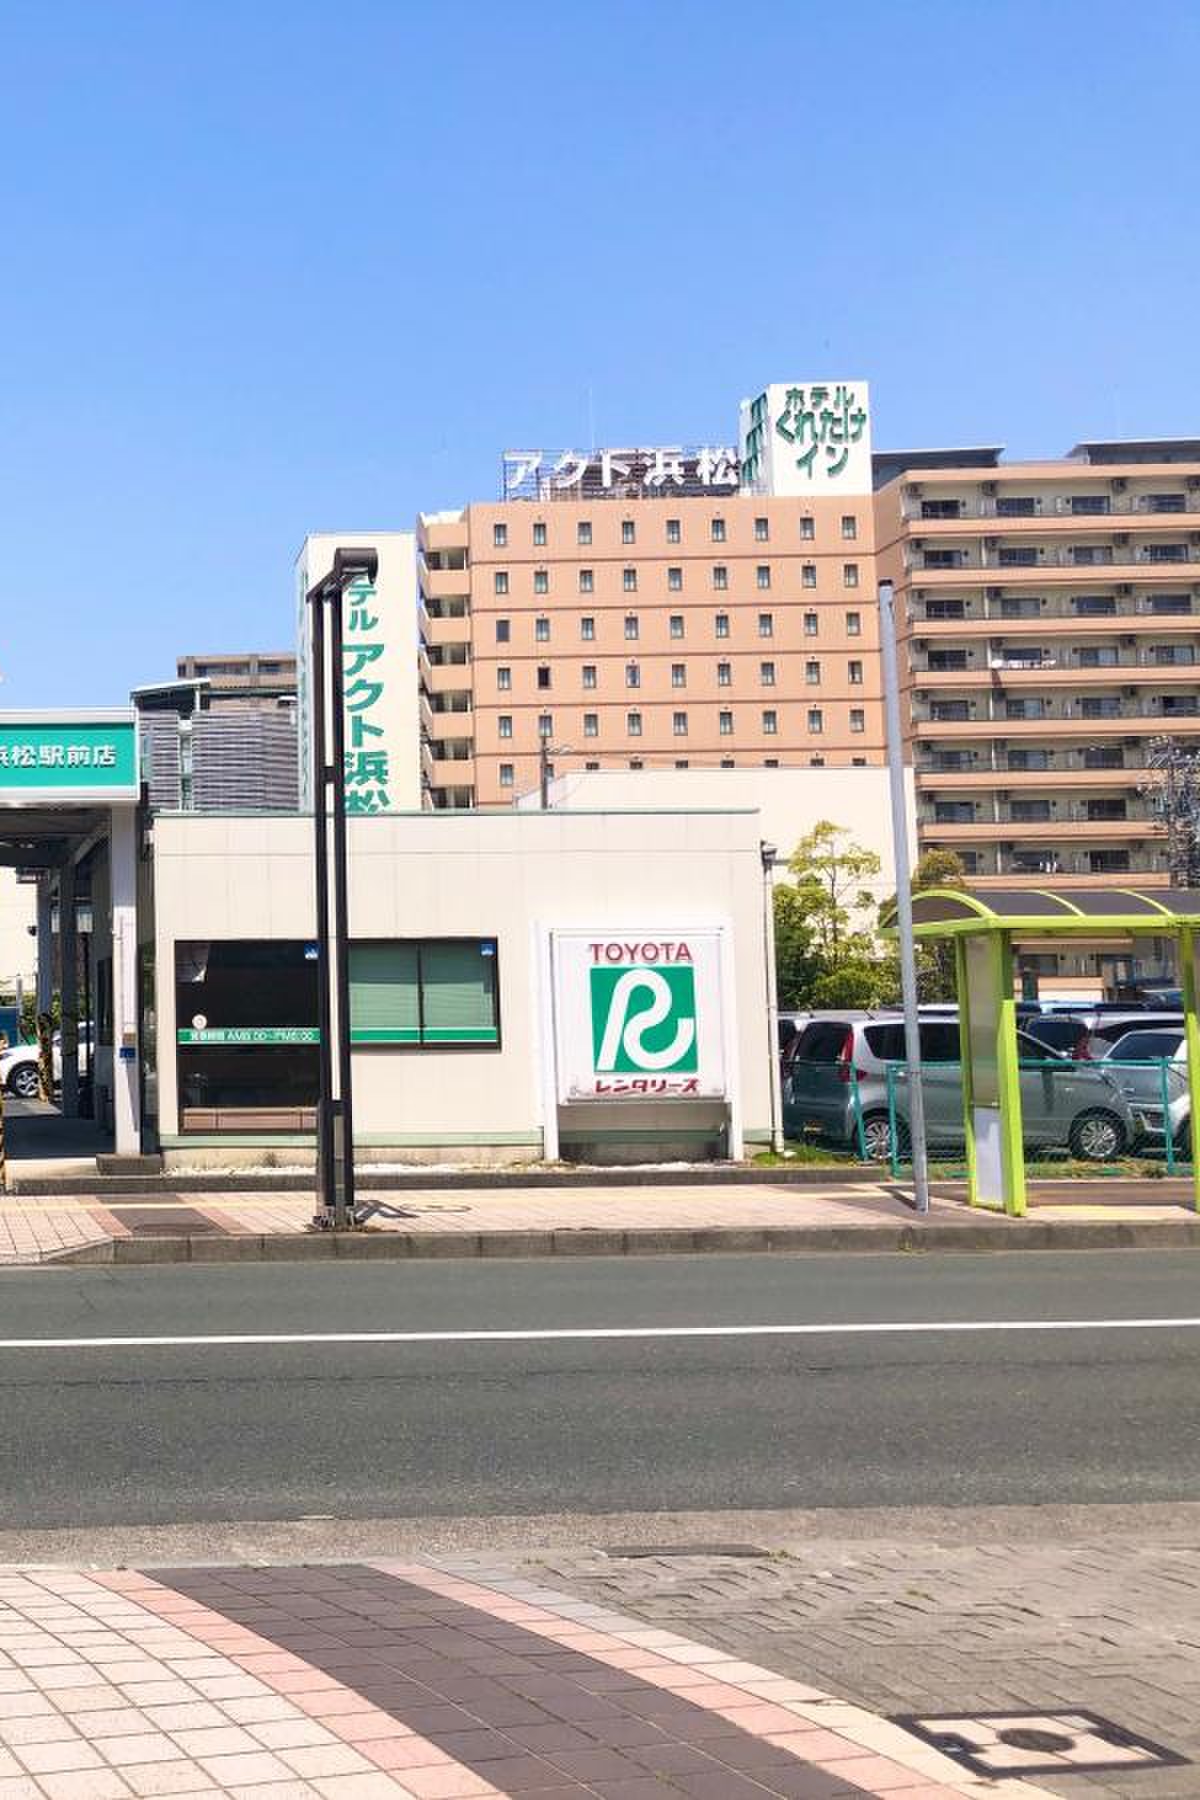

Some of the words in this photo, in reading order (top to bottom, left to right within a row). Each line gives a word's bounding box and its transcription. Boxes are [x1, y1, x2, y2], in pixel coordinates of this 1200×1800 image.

[785, 386, 855, 410] ホテル
[775, 408, 867, 444] くれたけ
[503, 449, 738, 489] アクト浜松
[796, 444, 849, 480] イン
[589, 942, 693, 962] TOYOTA
[595, 1078, 699, 1093] レンタリース
